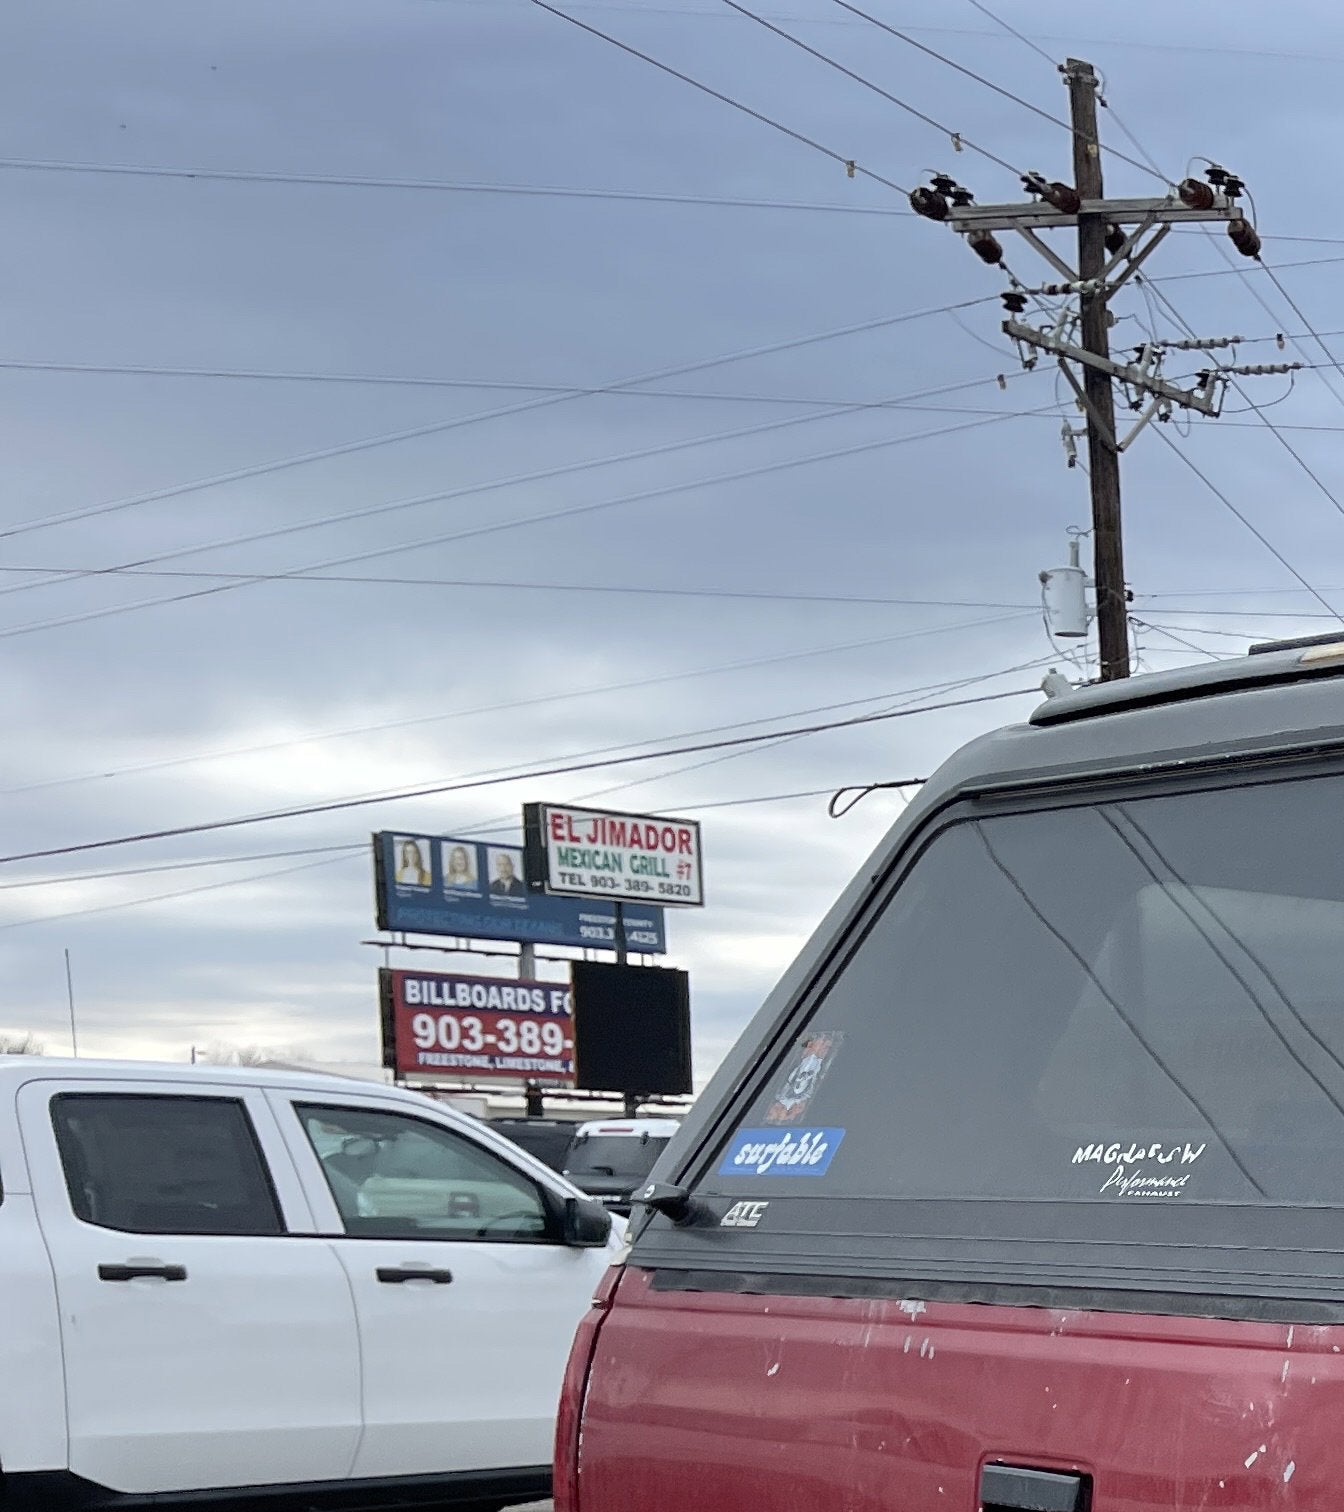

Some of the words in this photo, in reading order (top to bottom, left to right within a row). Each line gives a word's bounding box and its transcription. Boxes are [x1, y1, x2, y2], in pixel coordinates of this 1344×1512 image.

[551, 813, 581, 844] EL
[587, 817, 693, 855] JIMADOR
[557, 847, 623, 873] MEXICAN
[630, 853, 670, 878] GRILL
[558, 872, 586, 886] TEL
[405, 978, 546, 1013] BILLBOARDS
